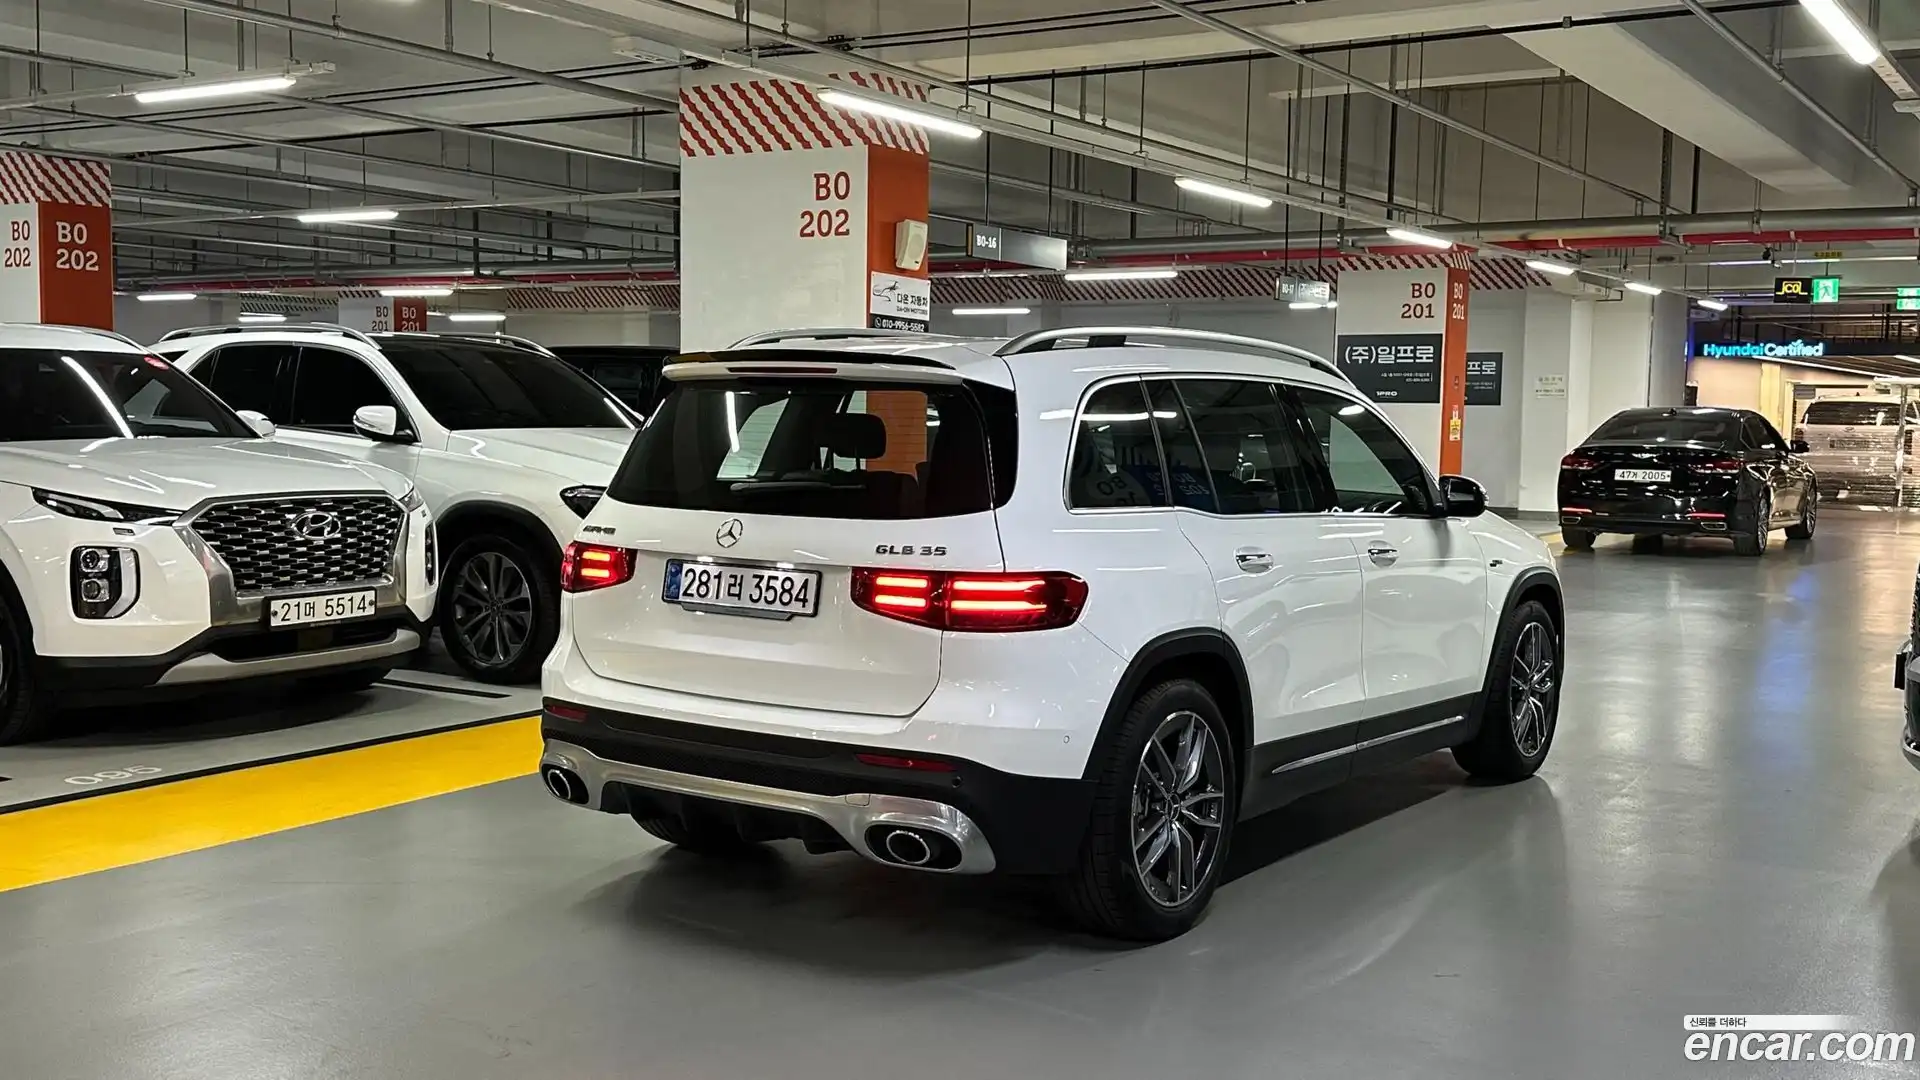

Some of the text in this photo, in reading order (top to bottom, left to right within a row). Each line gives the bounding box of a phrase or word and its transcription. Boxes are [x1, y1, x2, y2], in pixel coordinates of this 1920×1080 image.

[800, 209, 850, 237] 202
[5, 247, 31, 267] 202
[56, 248, 99, 271] 202
[1401, 303, 1435, 319] 201
[1452, 303, 1465, 320] 201
[372, 320, 389, 331] 201
[401, 321, 420, 332] 201
[1641, 471, 1666, 481] 2005
[876, 545, 947, 556] GLB 35
[682, 568, 809, 608] 281러 3584
[281, 594, 367, 622] 21머 5514
[64, 764, 162, 785] 095
